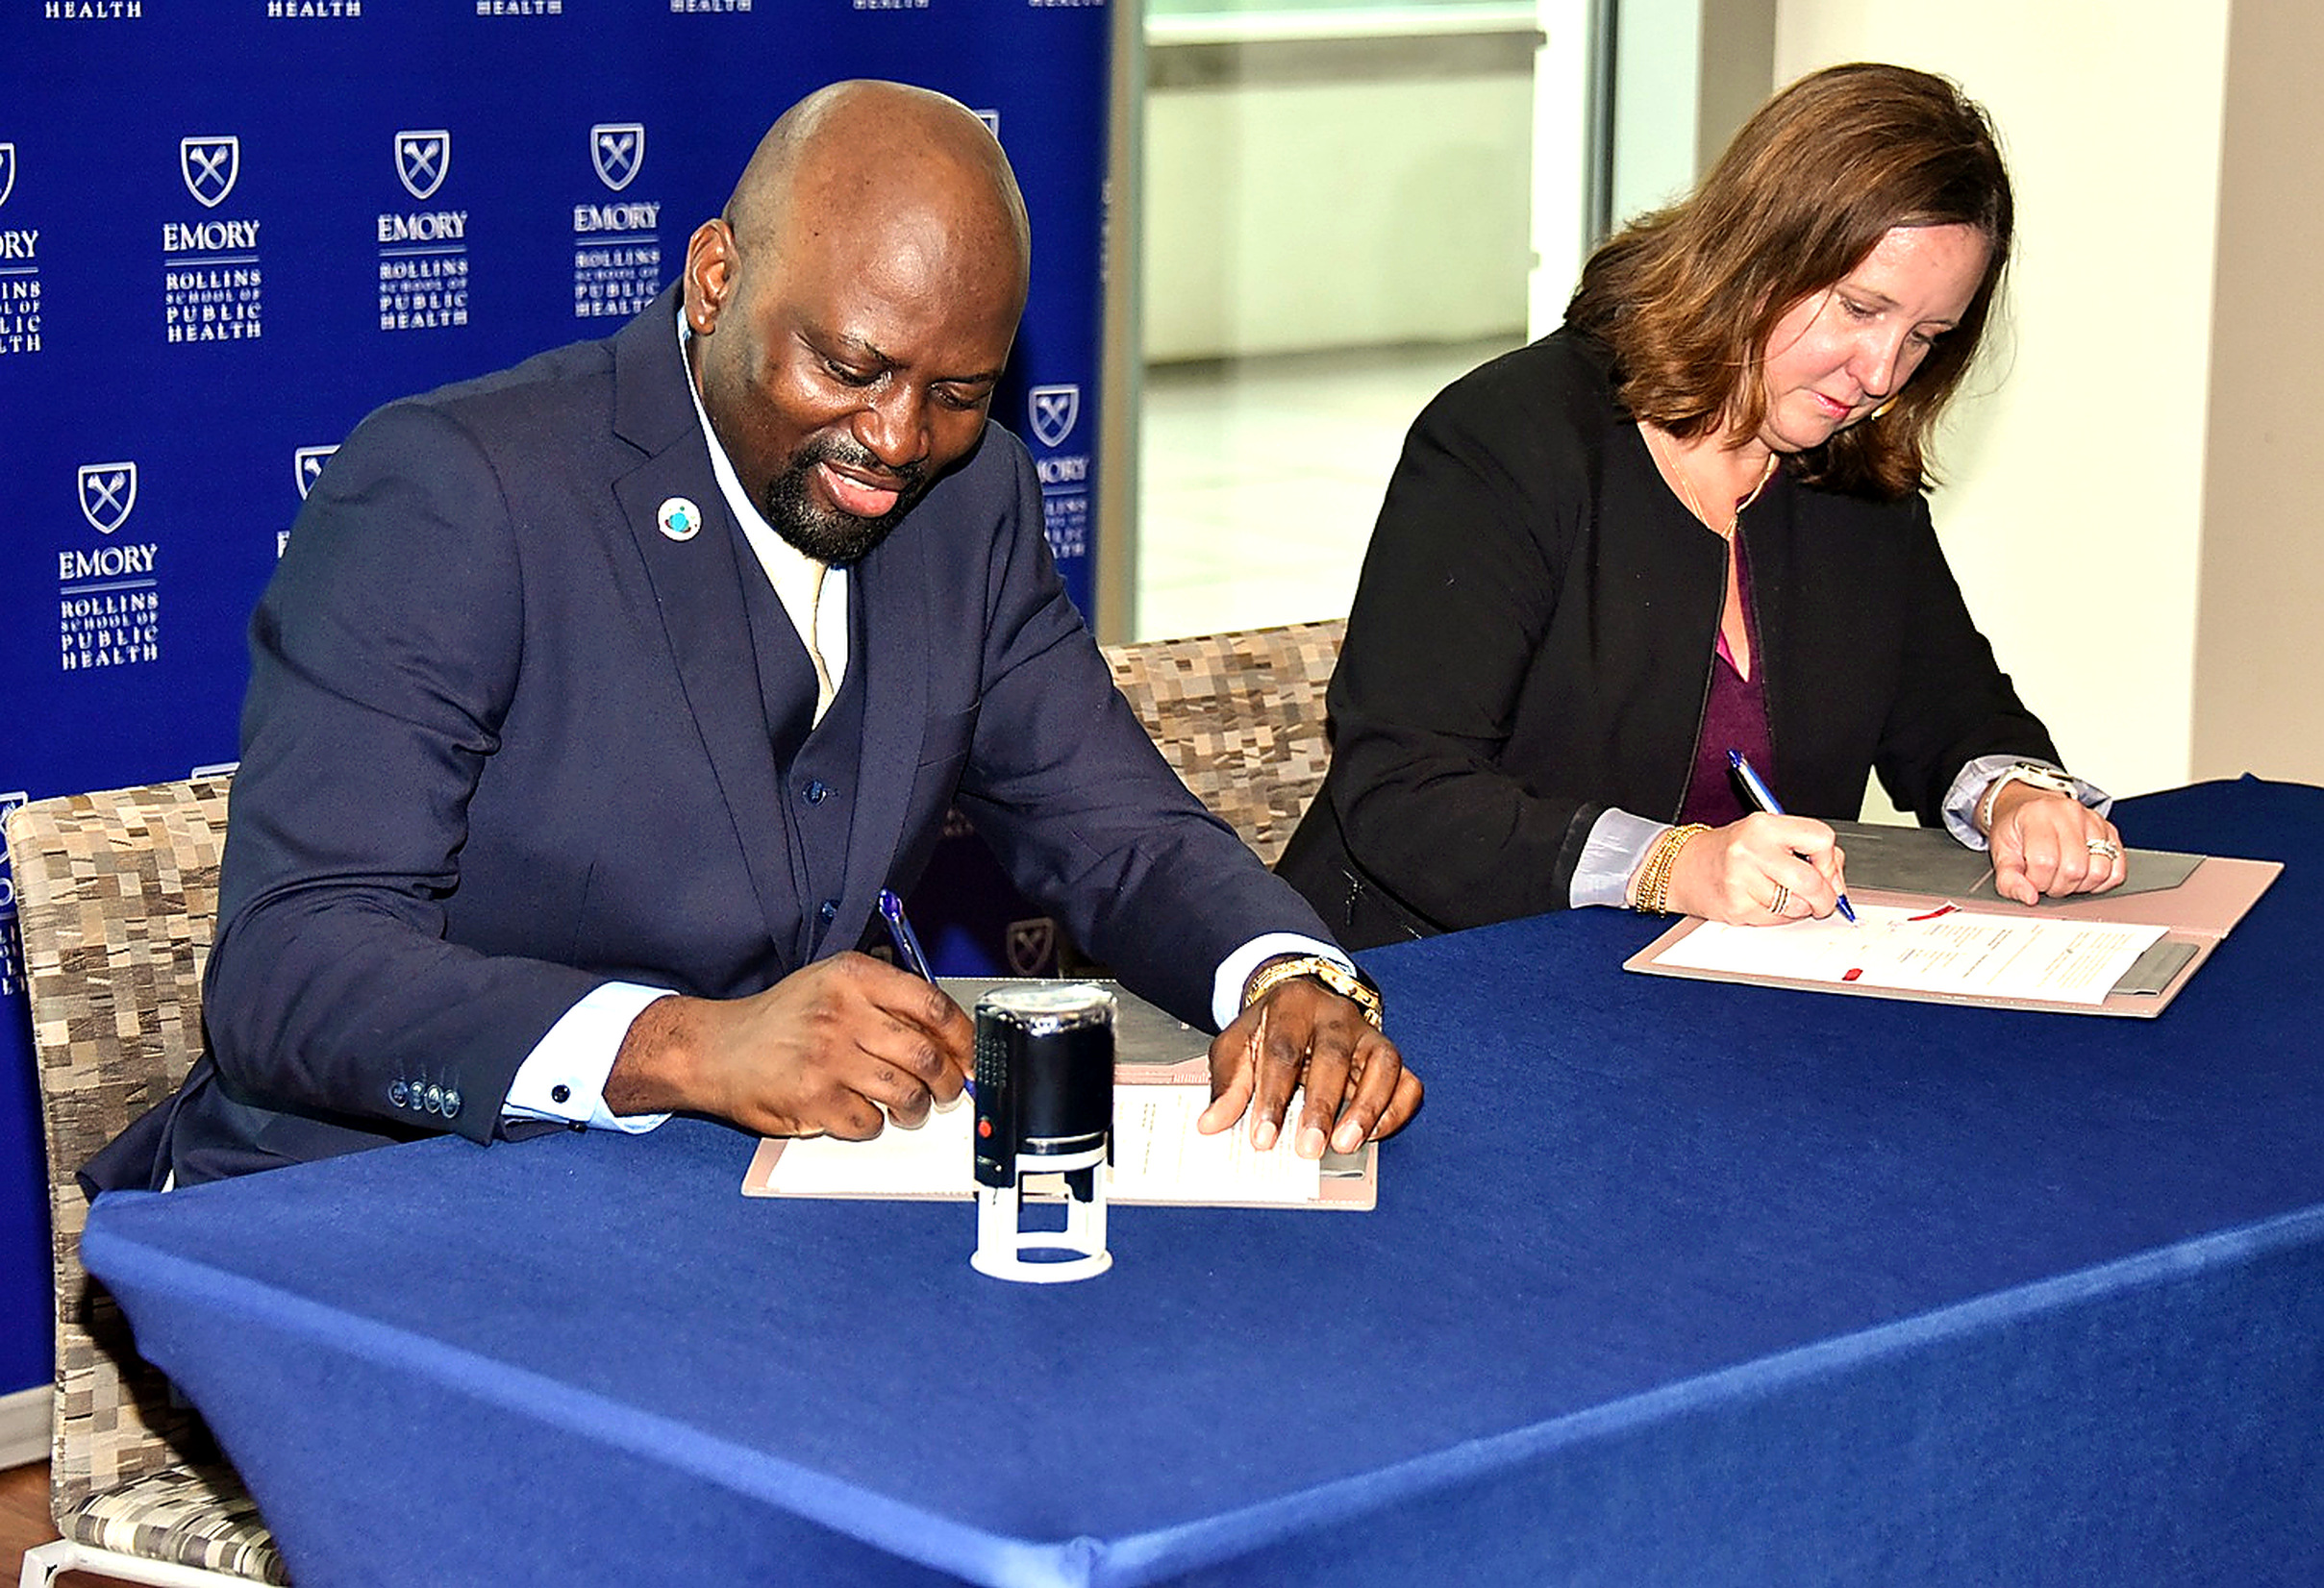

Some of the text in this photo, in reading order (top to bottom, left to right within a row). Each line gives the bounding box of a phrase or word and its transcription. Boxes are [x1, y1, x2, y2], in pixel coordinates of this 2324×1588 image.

[45, 1, 142, 18] HEALTH
[267, 0, 362, 17] HEALTH
[476, 0, 562, 15] HEALTH
[378, 210, 467, 241] EMORY
[574, 201, 661, 232] EMORY
[162, 219, 261, 251] EMORY
[165, 269, 262, 290] ROLLINS
[379, 259, 468, 280] ROLLINS
[165, 287, 261, 305] SCHOOL OF
[380, 290, 467, 311] PUBLIC
[166, 302, 262, 324] PUBLIC
[380, 308, 467, 330] HEALTH
[167, 320, 262, 342] HEALTH
[59, 543, 158, 580] EMORY
[62, 591, 159, 618] ROLLINS
[62, 610, 160, 633] SCHOOL OF
[62, 625, 159, 652] PUBLIC
[62, 643, 158, 670] HEALTH
